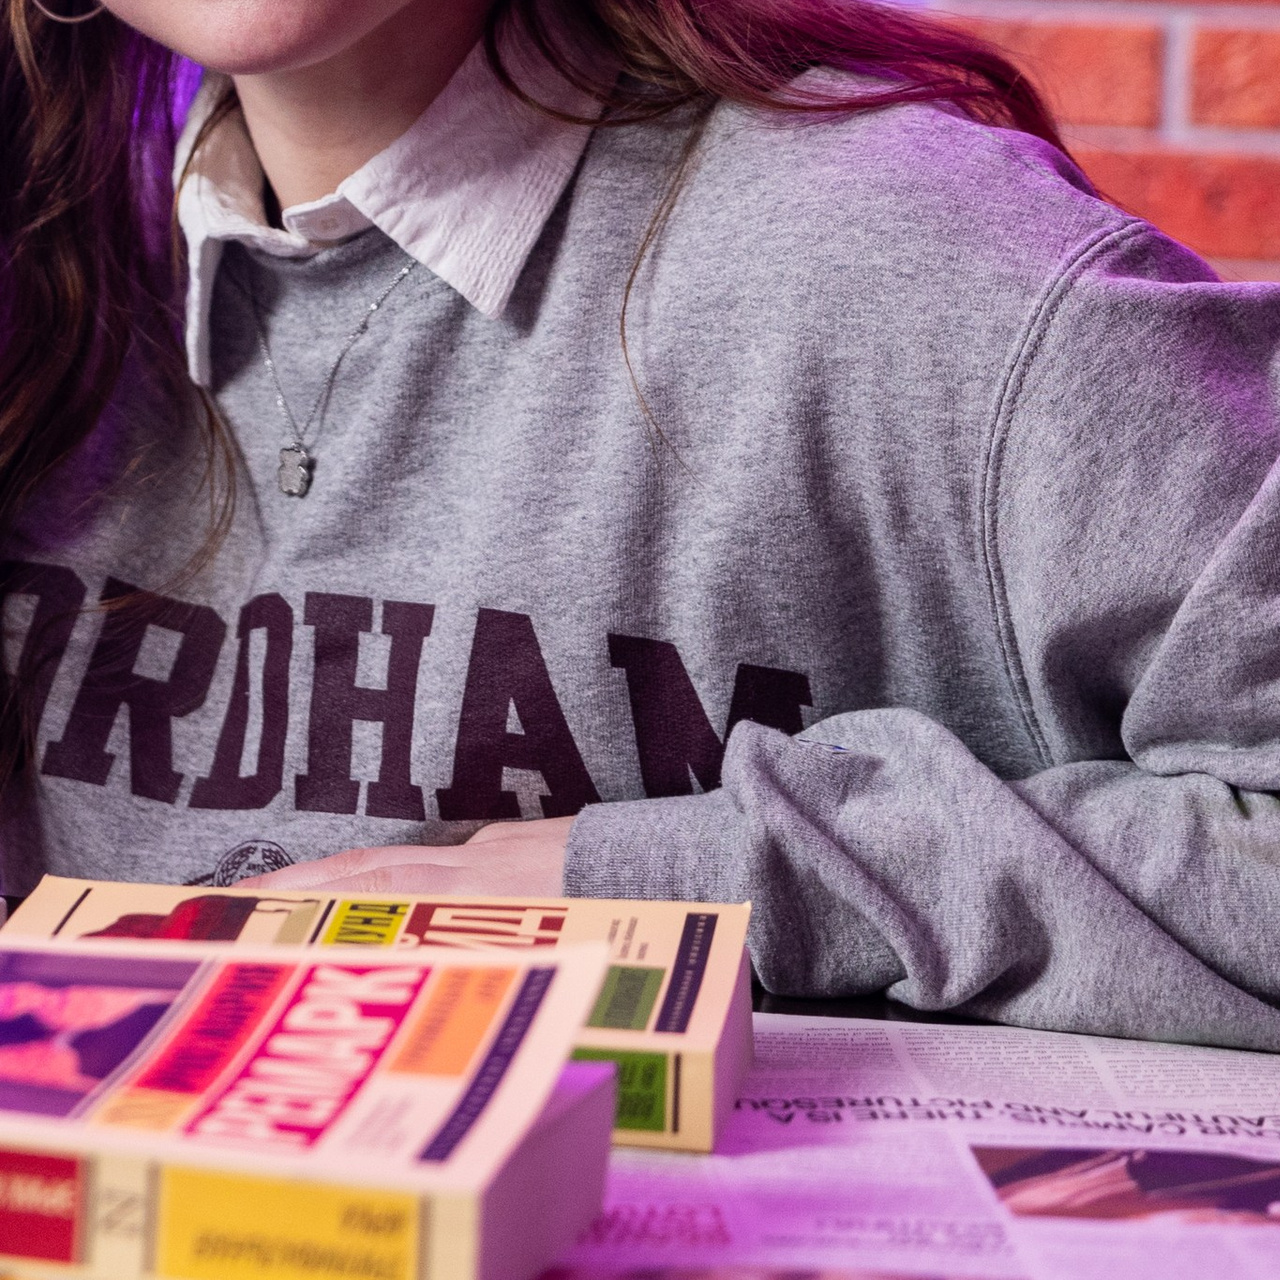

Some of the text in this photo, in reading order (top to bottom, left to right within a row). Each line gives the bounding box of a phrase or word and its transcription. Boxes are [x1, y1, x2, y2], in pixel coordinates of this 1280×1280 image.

[0, 558, 816, 823] ORDHAM
[732, 1096, 993, 1110] PICTURESQU
[1094, 1109, 1280, 1129] AUTIFUL
[767, 1110, 795, 1124] A
[853, 1107, 994, 1122] THERE
